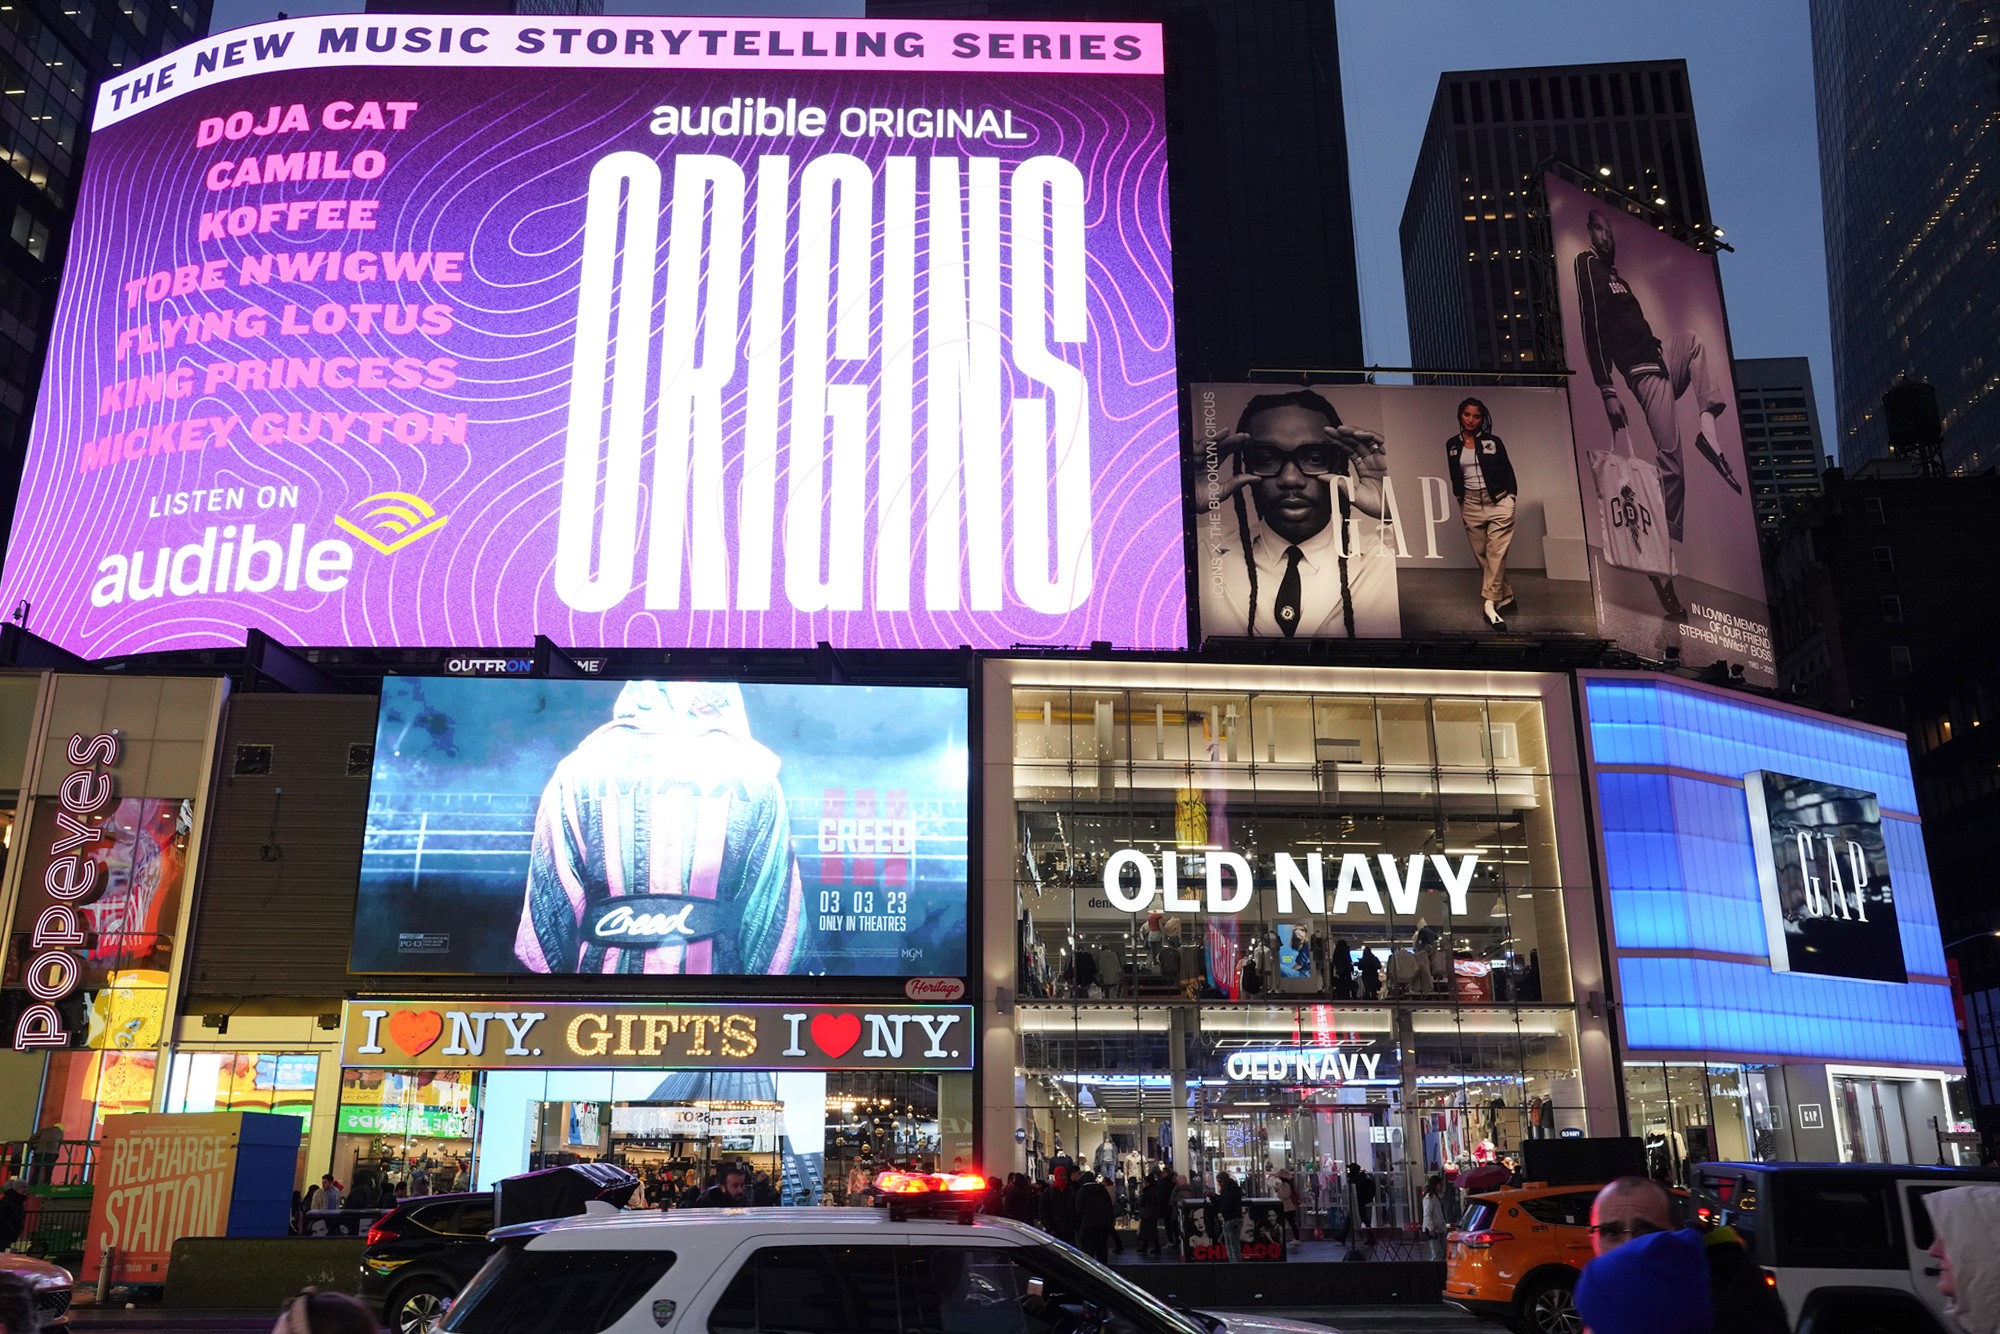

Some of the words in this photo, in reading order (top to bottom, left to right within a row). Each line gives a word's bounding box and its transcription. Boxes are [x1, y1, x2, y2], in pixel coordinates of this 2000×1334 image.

[111, 63, 175, 111] THE
[193, 32, 294, 77] NEW
[318, 27, 490, 54] MUSIC
[515, 27, 925, 58] STORYTELLING
[952, 32, 1142, 61] SERIES
[196, 104, 311, 148] DOJA
[321, 101, 418, 131] CAT
[650, 98, 826, 137] audible
[840, 107, 1027, 139] ORIGINAL
[206, 150, 387, 192] CAMILO
[197, 199, 379, 243] KOFFEE
[124, 260, 227, 310] TOBE
[239, 251, 465, 284] NWIGWE
[116, 305, 267, 362] FLYING
[280, 302, 454, 337] LOTUS
[99, 366, 195, 417] KING
[204, 357, 459, 395] PRINCESS
[554, 151, 1093, 615] ORIGINS
[1204, 391, 1217, 437] CIRCUS
[79, 415, 242, 474] MICKEY
[251, 411, 468, 446] GUYTON
[1206, 441, 1219, 510] BROOKLYN
[149, 488, 245, 519] LISTEN
[257, 485, 299, 510] ON
[1329, 475, 1451, 559] GAP
[1209, 513, 1221, 538] THE
[91, 523, 353, 608] audible
[1212, 557, 1224, 594] ICONS
[1691, 603, 1701, 615] IN
[1702, 606, 1732, 625] LOVING
[1733, 616, 1768, 636] MEMORY
[1709, 621, 1721, 633] OF
[1722, 625, 1742, 640] OUR
[1743, 632, 1770, 649] FRIEND
[1679, 623, 1718, 645] STEPHEN
[1750, 645, 1772, 662] BOSS
[449, 660, 535, 672] OUTFRON
[818, 819, 913, 853] CREED
[1104, 849, 1253, 914] OLD
[1275, 852, 1479, 916] NAVY
[1797, 828, 1872, 923] GAP
[595, 904, 695, 937] Creed
[819, 891, 840, 913] 03
[853, 891, 873, 914] 03
[887, 891, 907, 914] 23
[819, 915, 844, 931] ONLY
[846, 916, 856, 931] IN
[859, 916, 907, 932] THEATRES
[901, 948, 923, 961] MGM
[911, 980, 960, 998] Heritage
[358, 1010, 387, 1055] I
[566, 1013, 758, 1057] GIFTS
[782, 1014, 807, 1057] I
[1228, 1053, 1288, 1081] OLD
[1296, 1053, 1381, 1080] NAVY
[1803, 1110, 1818, 1122] GAP
[108, 1136, 228, 1188] RECHARGE
[100, 1171, 224, 1253] STATION
[1193, 1243, 1282, 1261] CHIAGO
